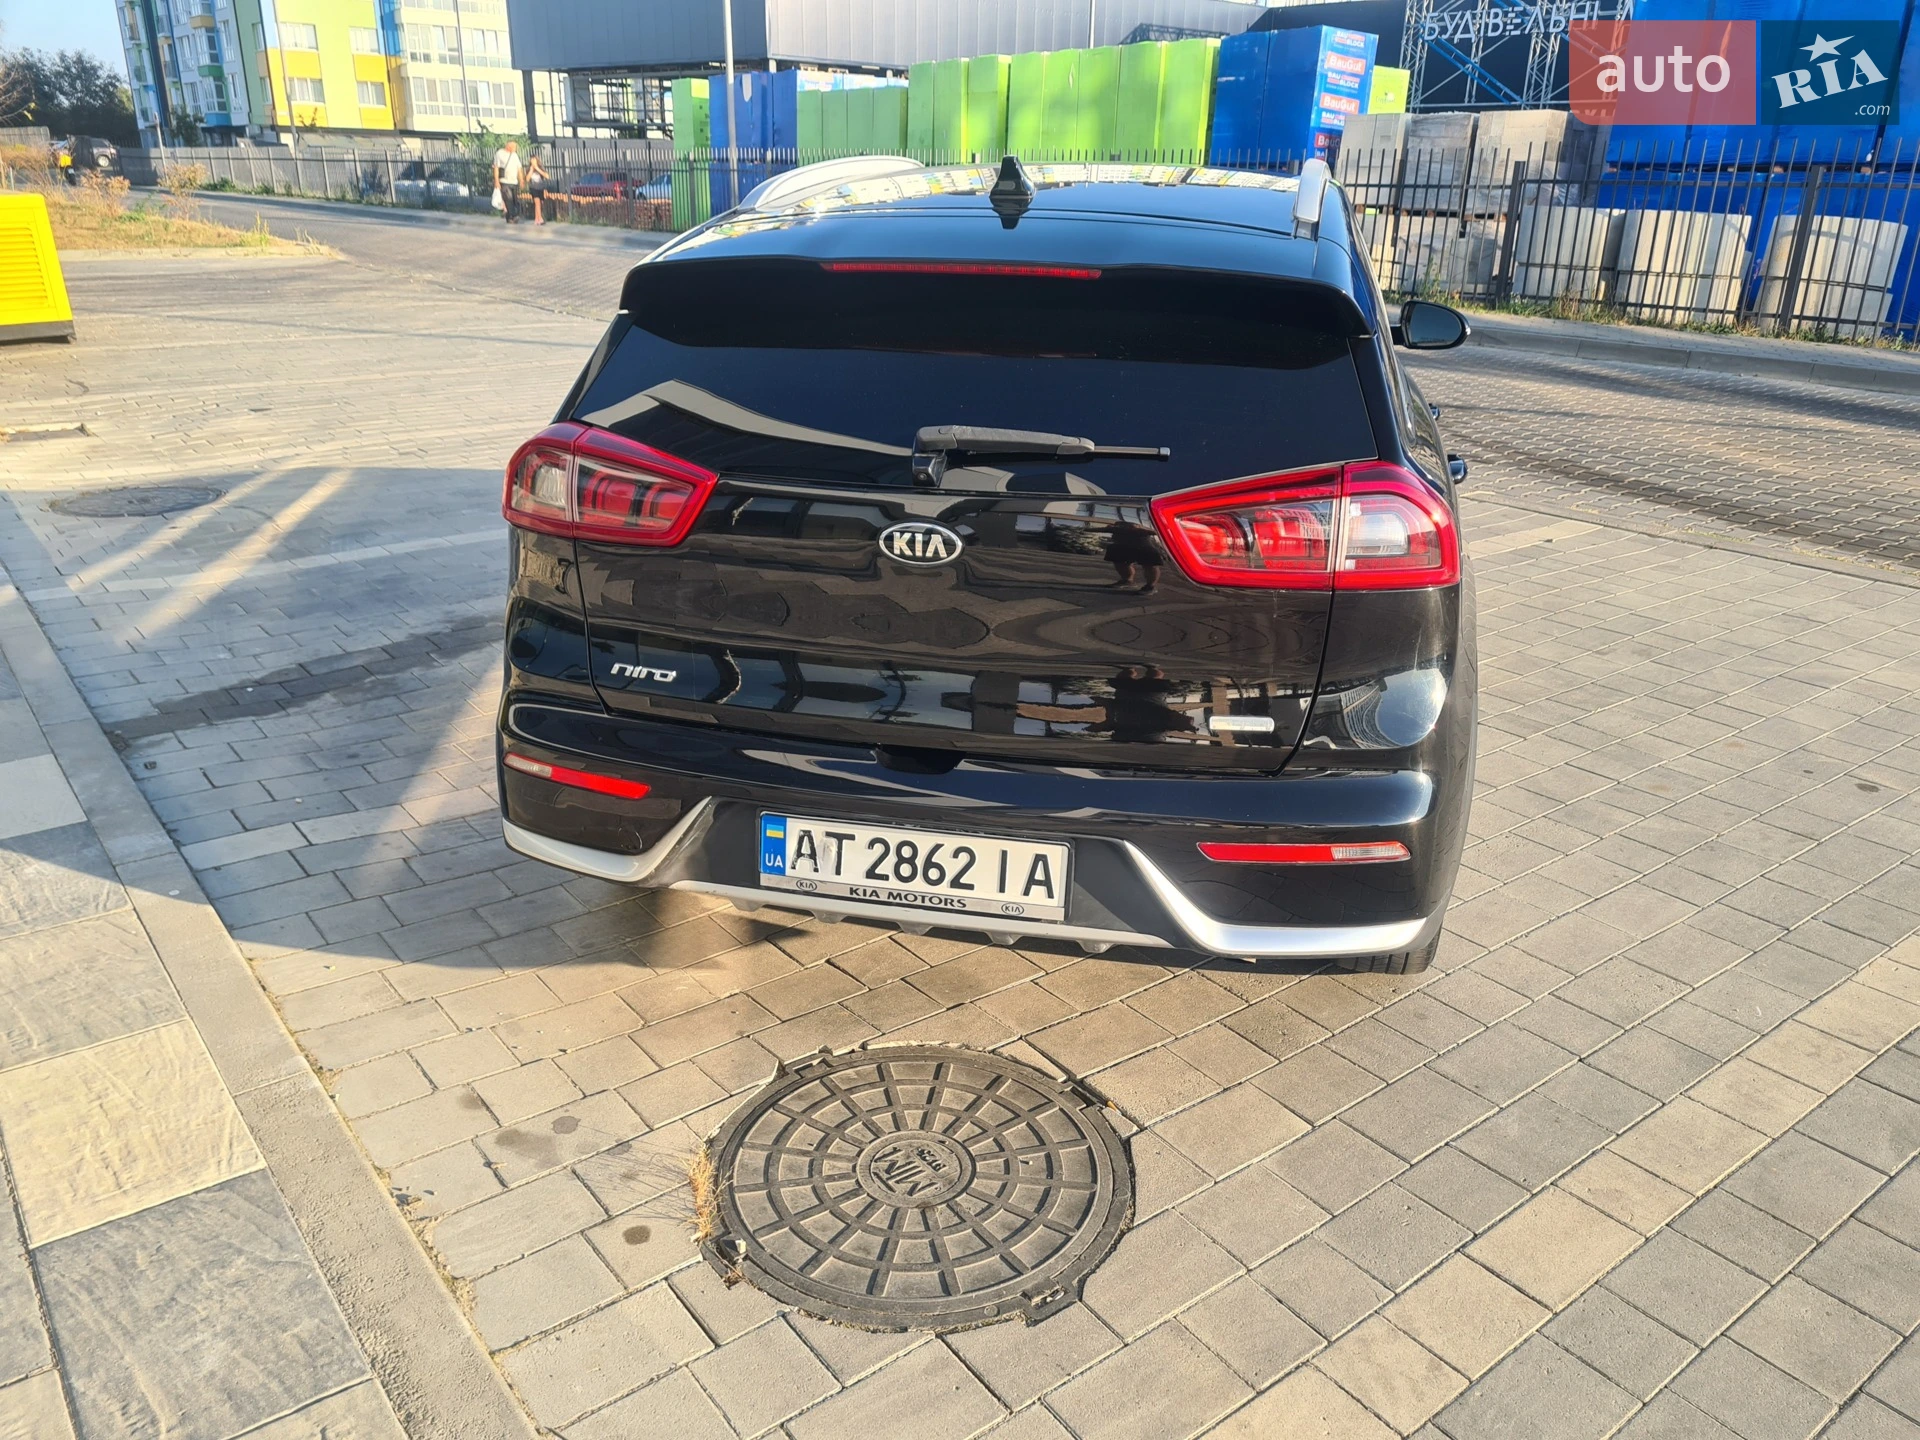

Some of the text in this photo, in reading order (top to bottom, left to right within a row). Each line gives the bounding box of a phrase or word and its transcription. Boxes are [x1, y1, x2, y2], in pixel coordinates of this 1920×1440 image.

[1424, 0, 1600, 43] БУДІВЕЛЬНІ
[1346, 38, 1365, 48] BLOCK
[1329, 55, 1362, 72] BauGut
[1327, 71, 1341, 80] BAU
[1339, 79, 1359, 89] BLOCK
[1323, 95, 1356, 112] BauGut
[1321, 111, 1335, 120] BAU
[1317, 134, 1341, 148] BauG
[892, 531, 948, 558] KIA
[610, 663, 677, 682] niro
[765, 853, 784, 868] UA
[790, 829, 1055, 900] AT 2862 IA
[799, 881, 814, 889] KIA
[849, 887, 967, 908] KIA MOTORS
[1004, 905, 1021, 913] KIA
